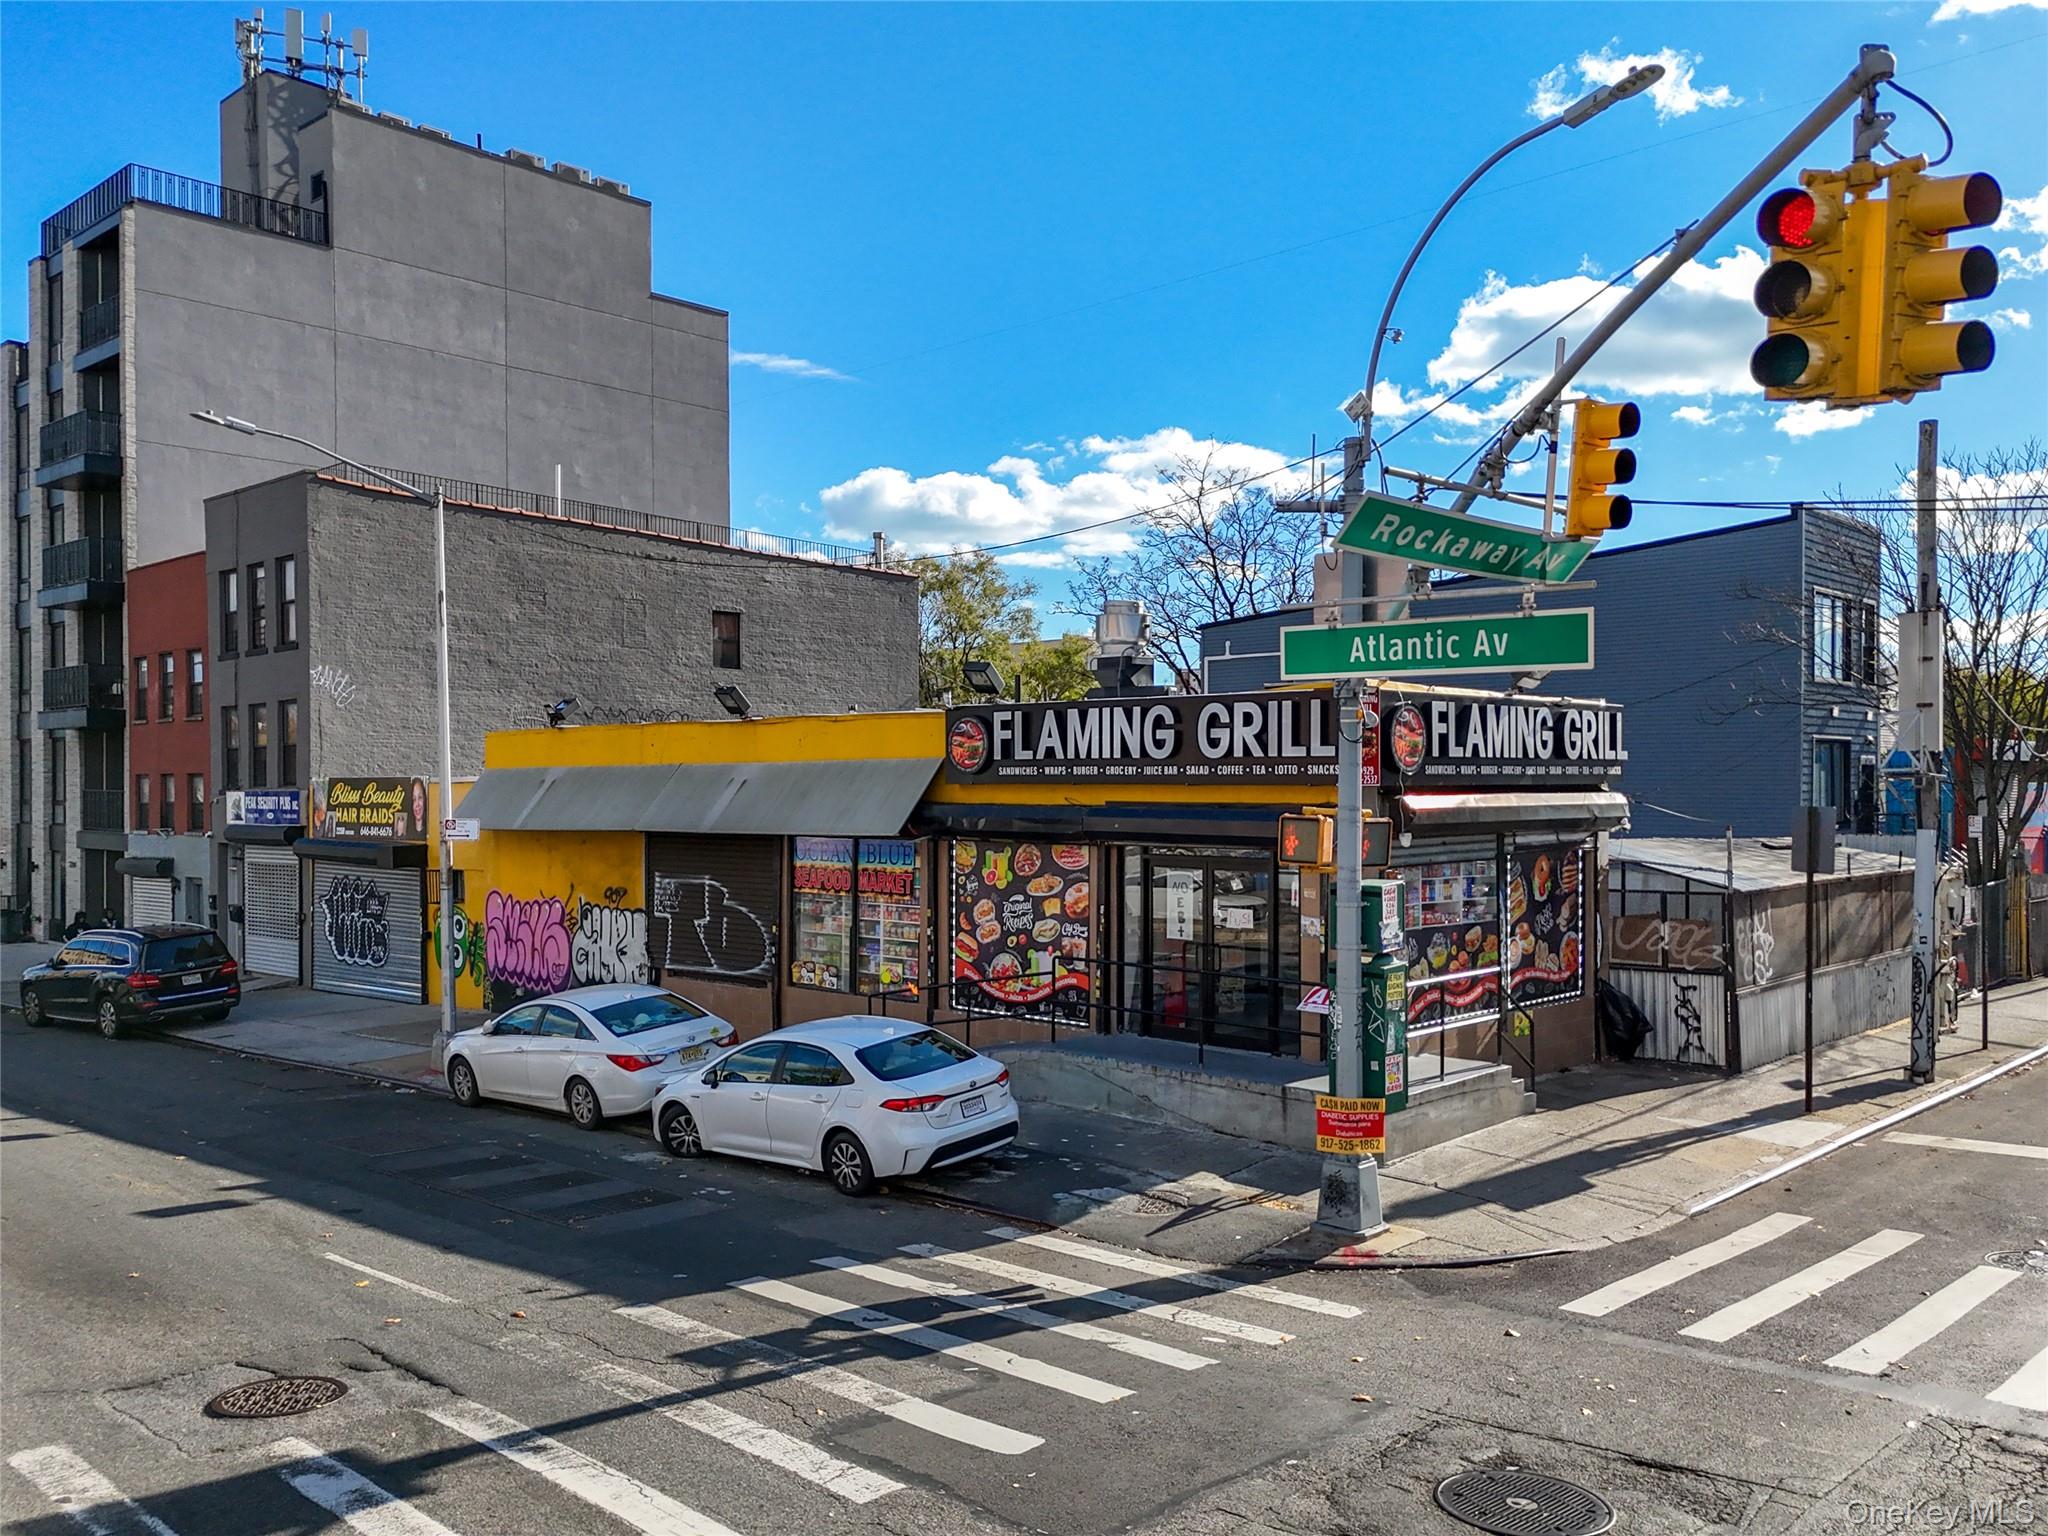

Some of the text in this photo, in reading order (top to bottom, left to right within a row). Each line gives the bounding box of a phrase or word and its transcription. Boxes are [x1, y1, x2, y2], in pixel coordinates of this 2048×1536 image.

[1370, 514, 1567, 572] Rockaway Av
[1350, 629, 1509, 663] Atlantic Av
[993, 699, 1336, 760] FLAMING GRILL
[1431, 700, 1629, 761] FLAMING GRILL
[998, 764, 1340, 776] SANDWICHES WRAPS BURGER GROCERY JUICE BAR SALAD COFFEE TEA LOTTO SNACKS
[279, 796, 291, 810] PLUS
[330, 781, 405, 812] Bliss Beauty
[336, 807, 394, 824] HAIR BRAIDS
[796, 840, 913, 866] OCEAN BLUE
[794, 867, 914, 894] SEAFOOD MARKET
[1321, 1111, 1347, 1120] DIABETIC
[1340, 1101, 1358, 1111] PAID
[1361, 1101, 1380, 1111] NOW
[1320, 1137, 1381, 1151] 917-525-1862
